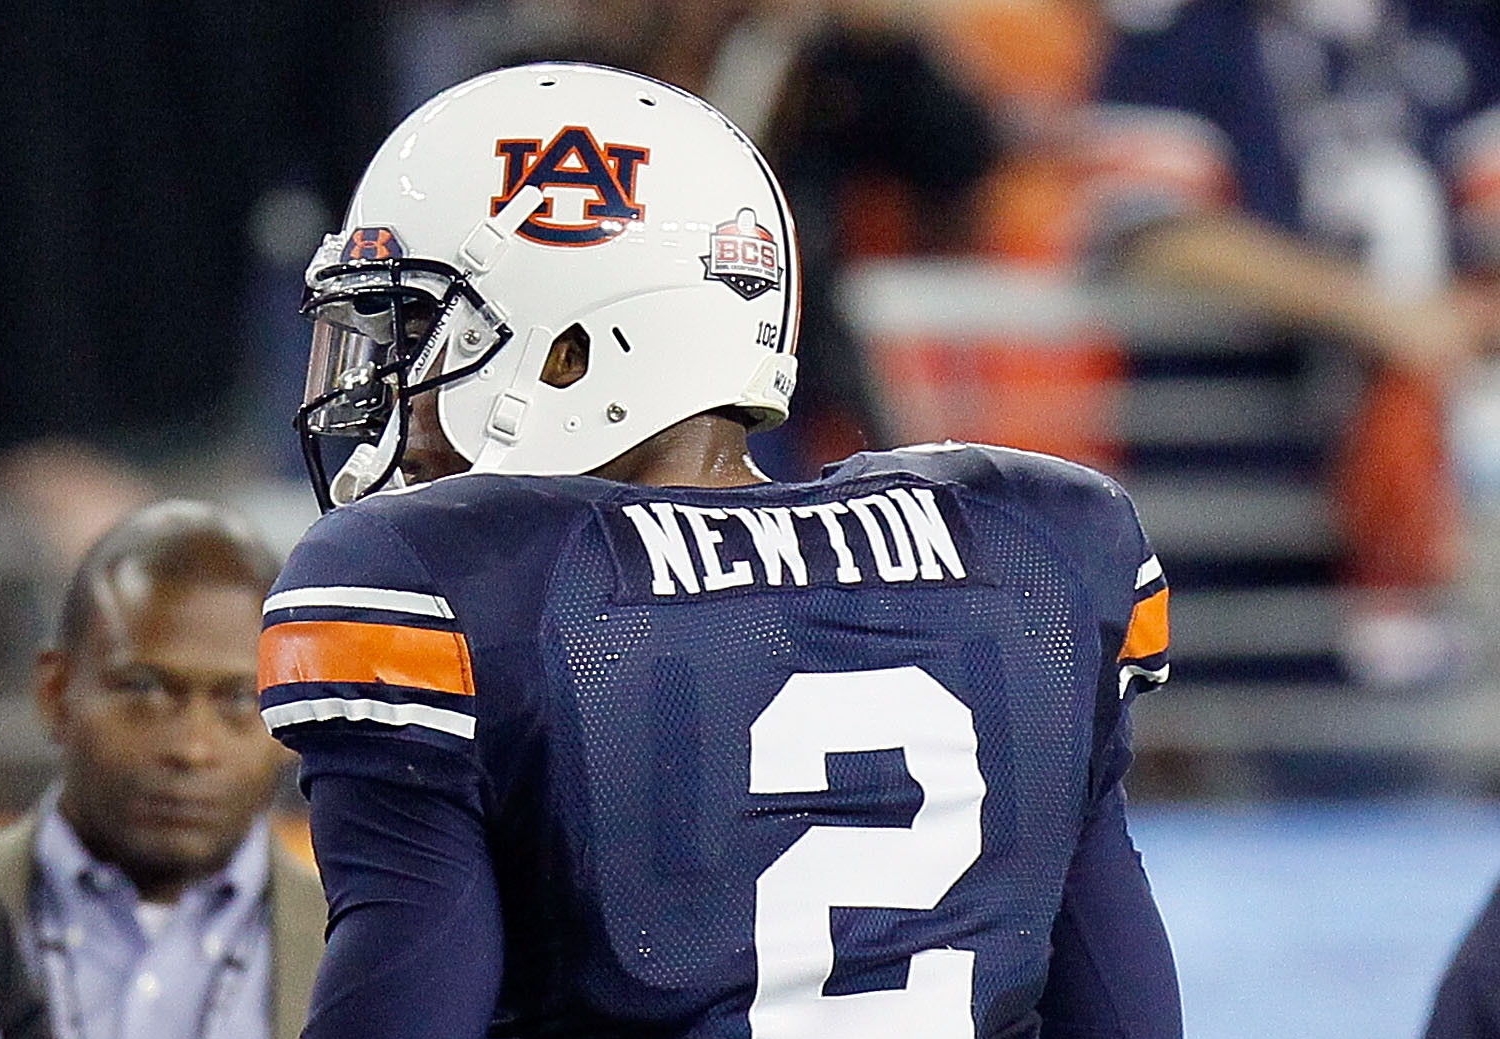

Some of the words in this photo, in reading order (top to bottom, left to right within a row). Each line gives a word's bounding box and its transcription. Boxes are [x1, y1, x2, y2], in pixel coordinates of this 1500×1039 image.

[490, 125, 650, 248] AU
[715, 240, 775, 271] BCS
[414, 319, 446, 376] AUBURN
[755, 320, 778, 349] 102
[622, 487, 967, 596] NEWTON
